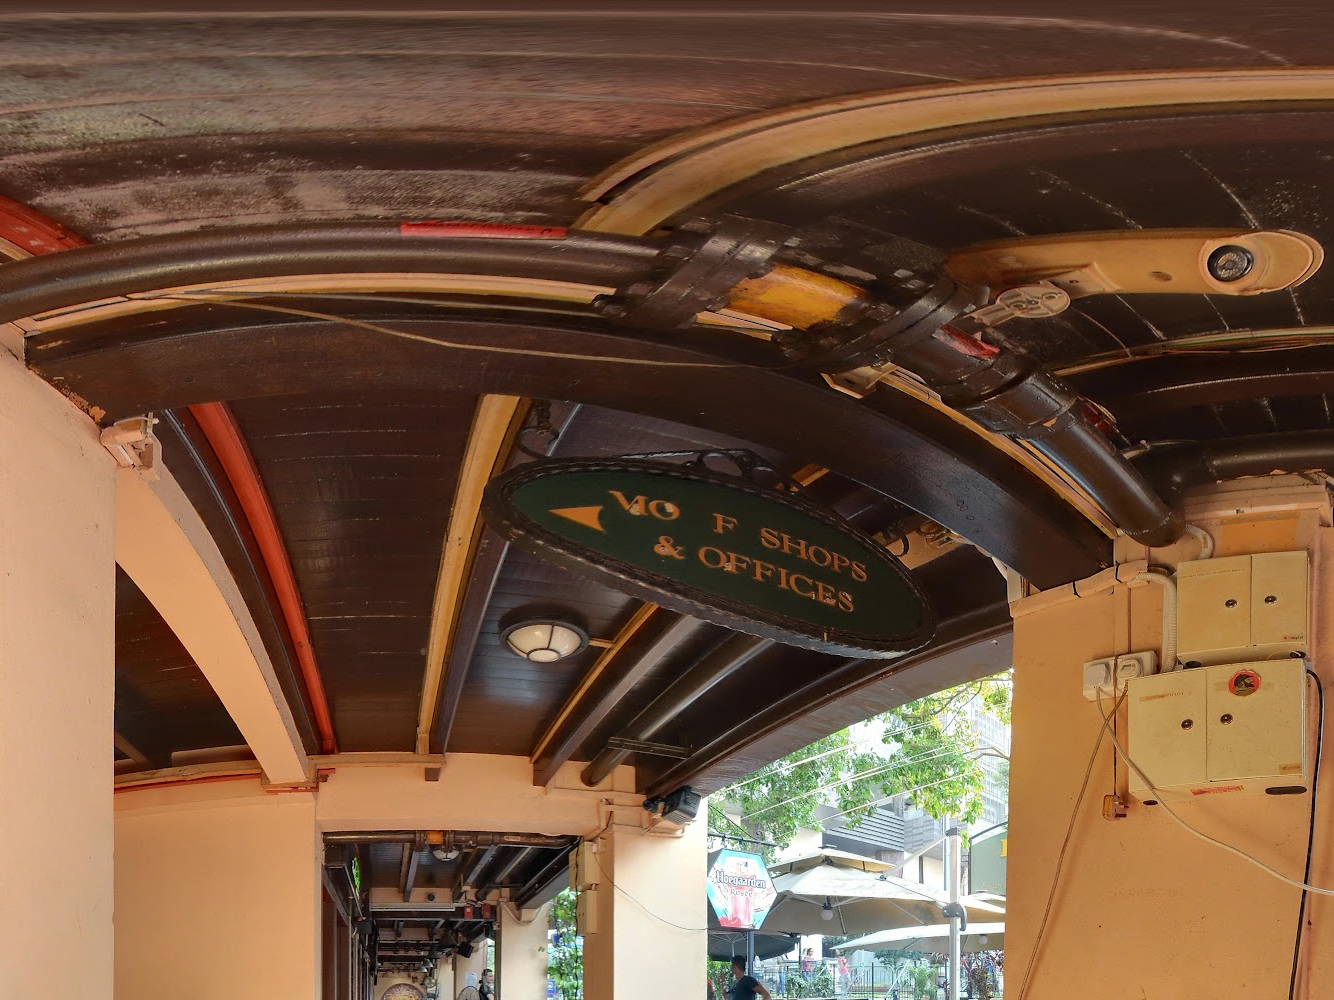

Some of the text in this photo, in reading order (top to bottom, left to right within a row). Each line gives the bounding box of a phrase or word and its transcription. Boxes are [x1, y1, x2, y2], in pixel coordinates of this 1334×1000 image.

[653, 535, 855, 613] & OFFICES
[760, 527, 869, 583] SHOPS
[716, 869, 766, 889] Hoegaarden
